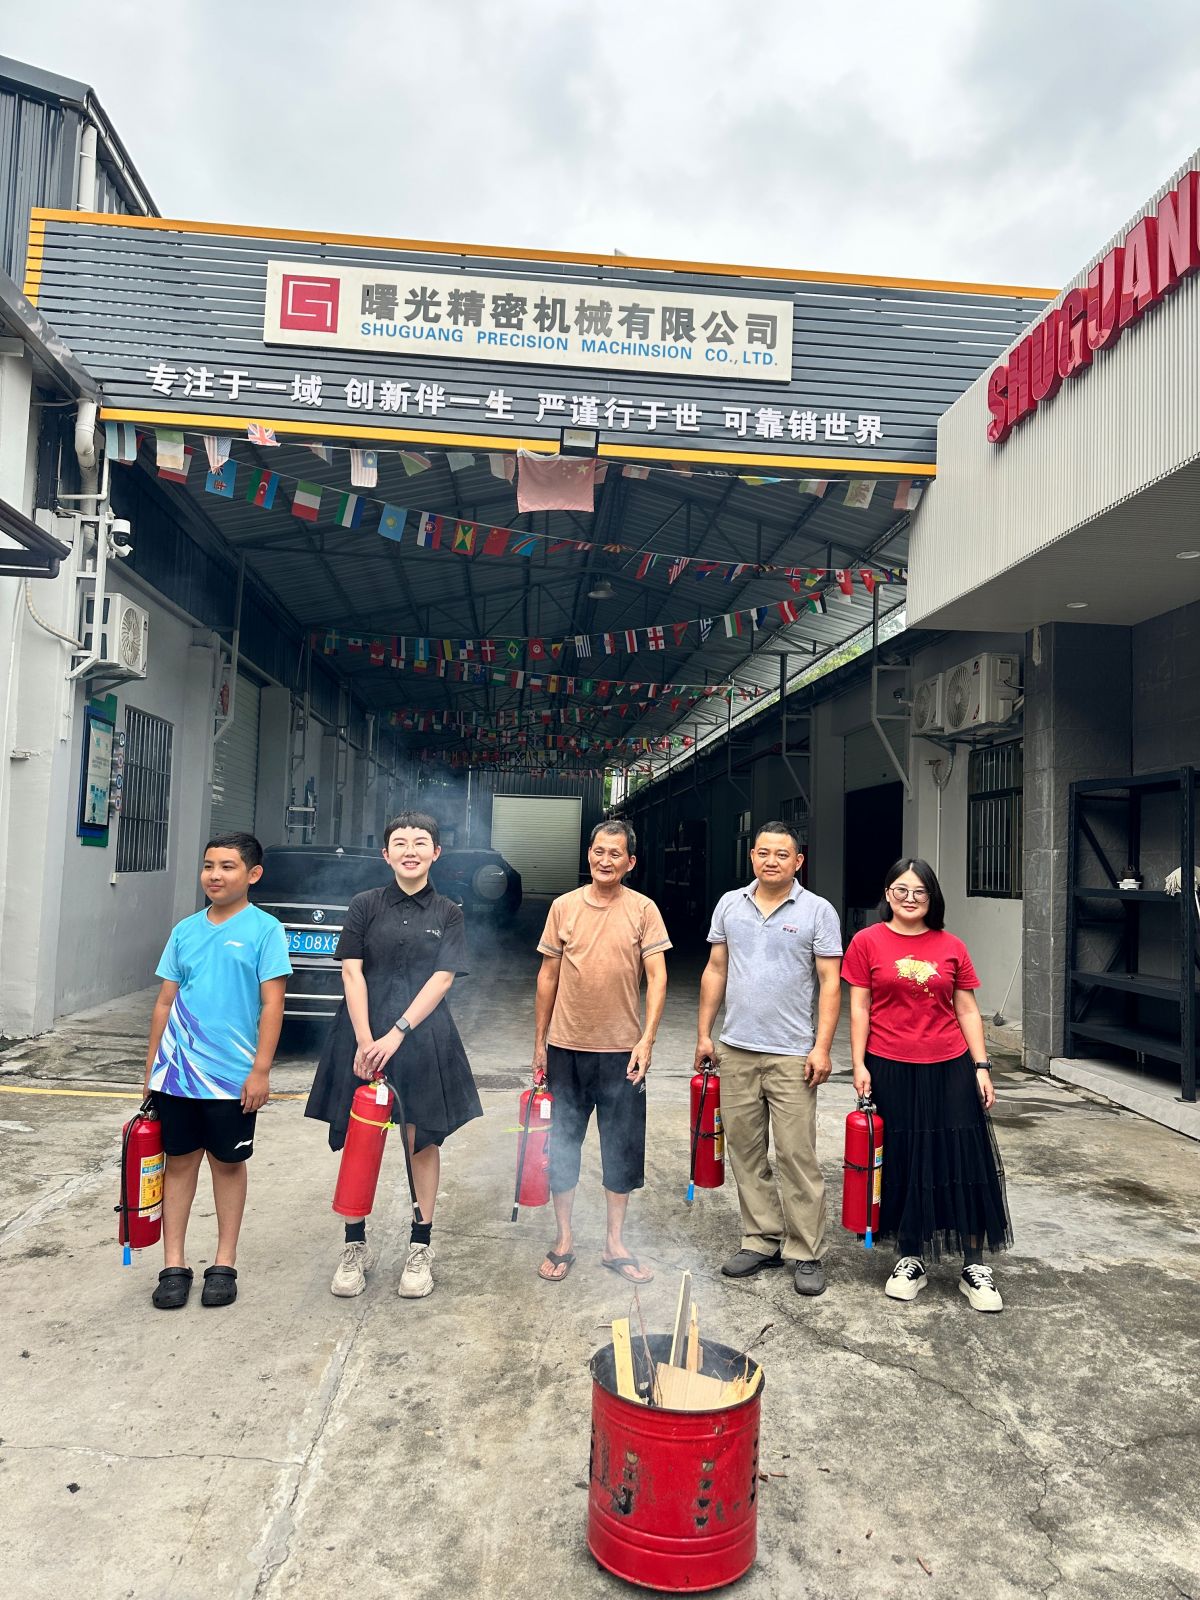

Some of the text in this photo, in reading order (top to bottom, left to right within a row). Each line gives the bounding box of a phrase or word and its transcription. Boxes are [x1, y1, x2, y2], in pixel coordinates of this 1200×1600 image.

[361, 283, 778, 350] 曙光精密机械有限公司
[361, 322, 464, 343] SHUGUANG
[477, 330, 569, 351] PRECISION
[581, 338, 693, 360] MACHINSION
[987, 171, 1200, 443] SHUGUAN
[145, 362, 885, 445] 专注于一域 创新伴一生 严谨行于世 可靠销世界
